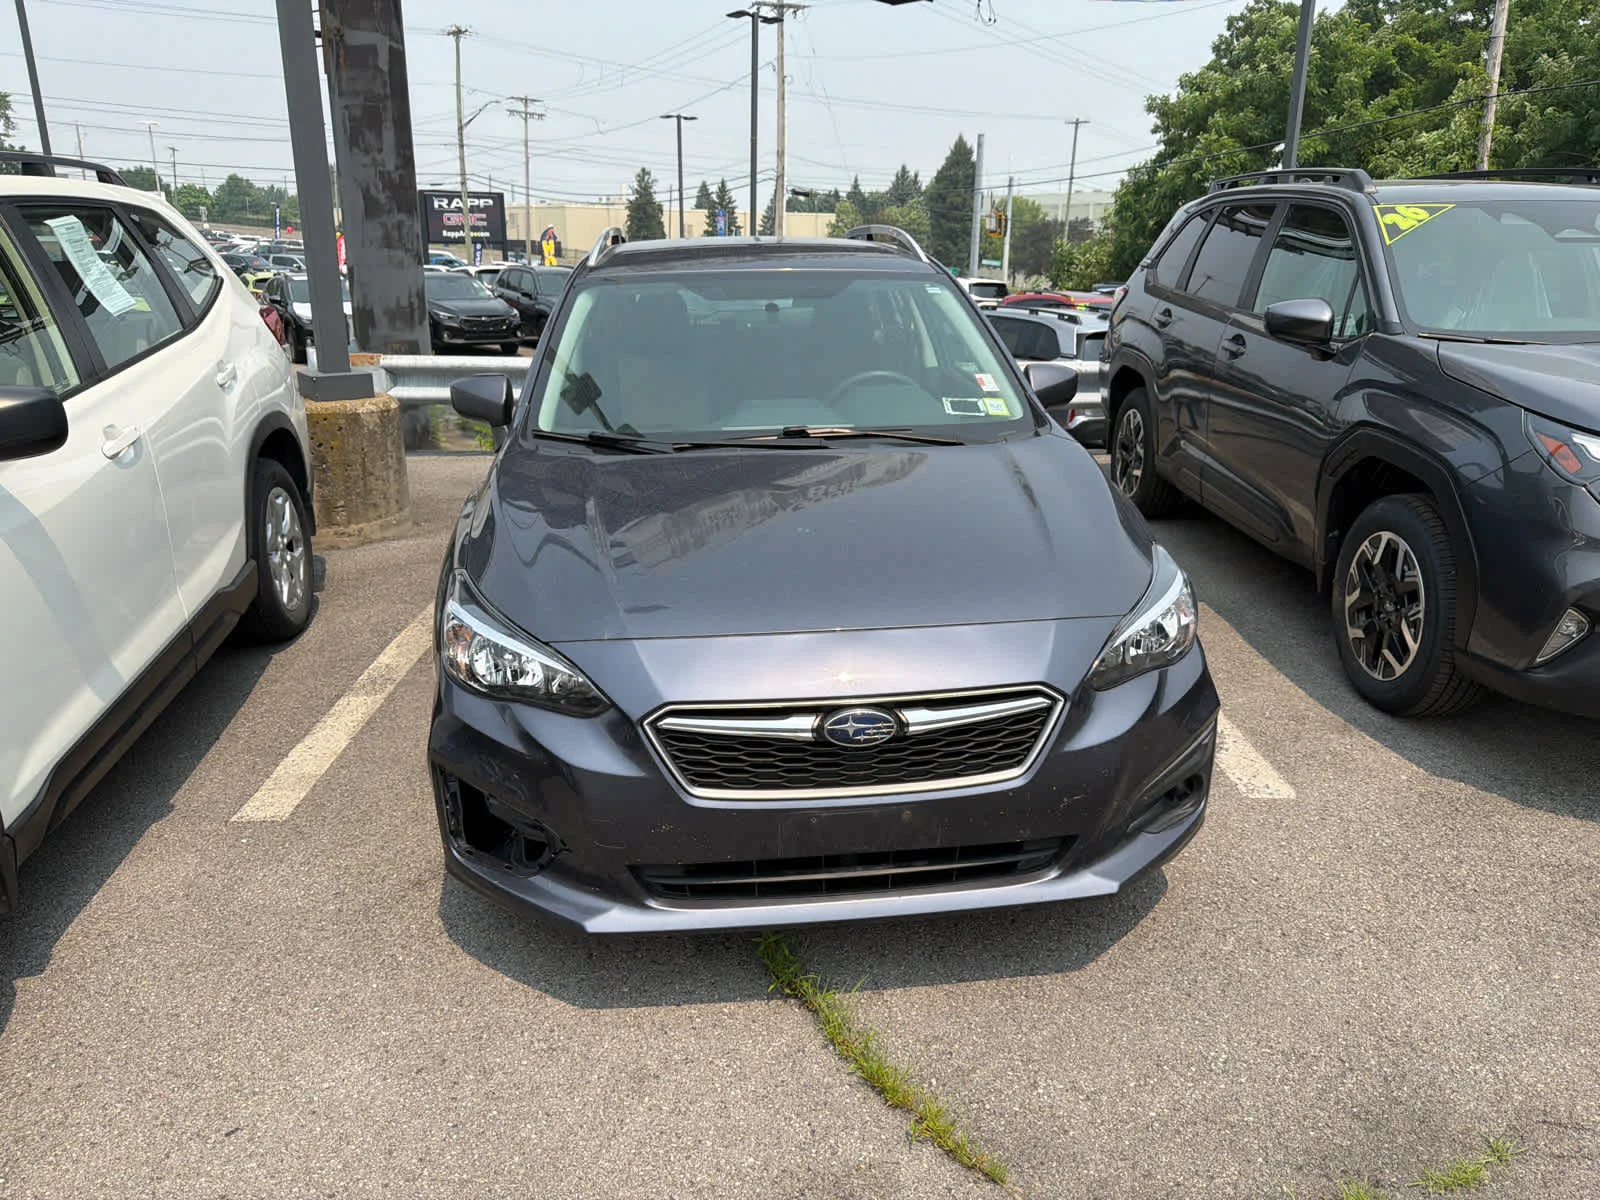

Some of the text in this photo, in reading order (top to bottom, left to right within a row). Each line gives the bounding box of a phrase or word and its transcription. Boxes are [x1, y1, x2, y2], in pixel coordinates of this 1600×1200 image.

[433, 197, 493, 209] RAPP
[443, 213, 487, 226] GMC
[1382, 206, 1430, 230] 26
